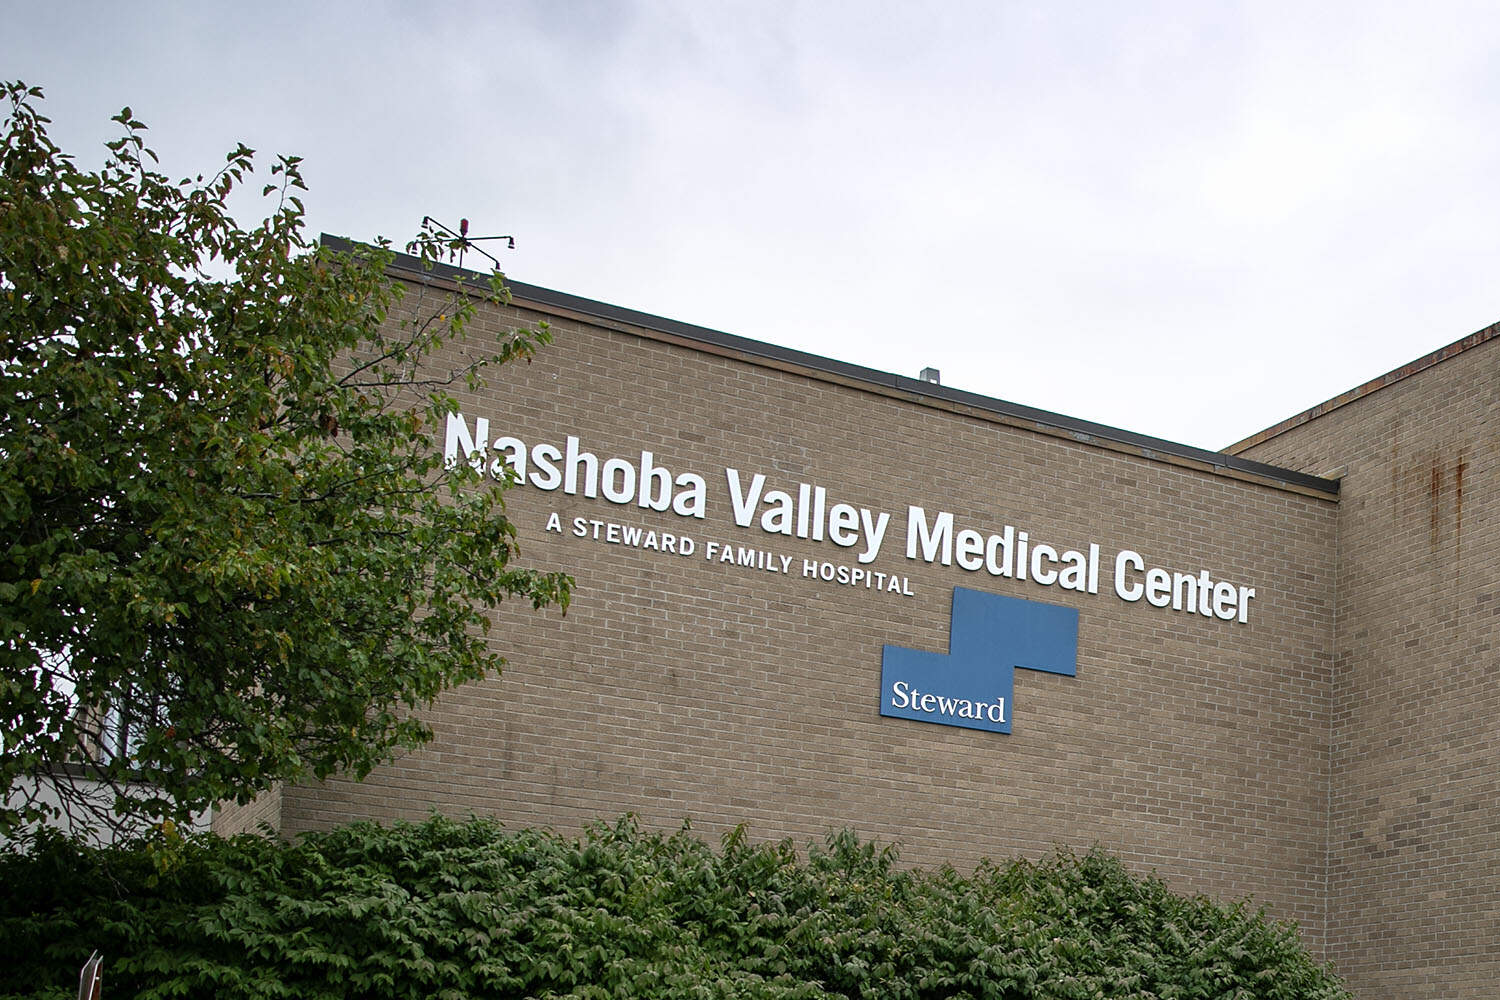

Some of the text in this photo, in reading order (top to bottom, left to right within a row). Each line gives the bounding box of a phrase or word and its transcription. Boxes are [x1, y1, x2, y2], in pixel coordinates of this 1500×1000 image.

[444, 411, 1256, 624] Nashoba Valley Medical Center
[545, 512, 915, 597] A STEWARD FAMILY HOSPITAL
[891, 681, 1007, 724] Steward
